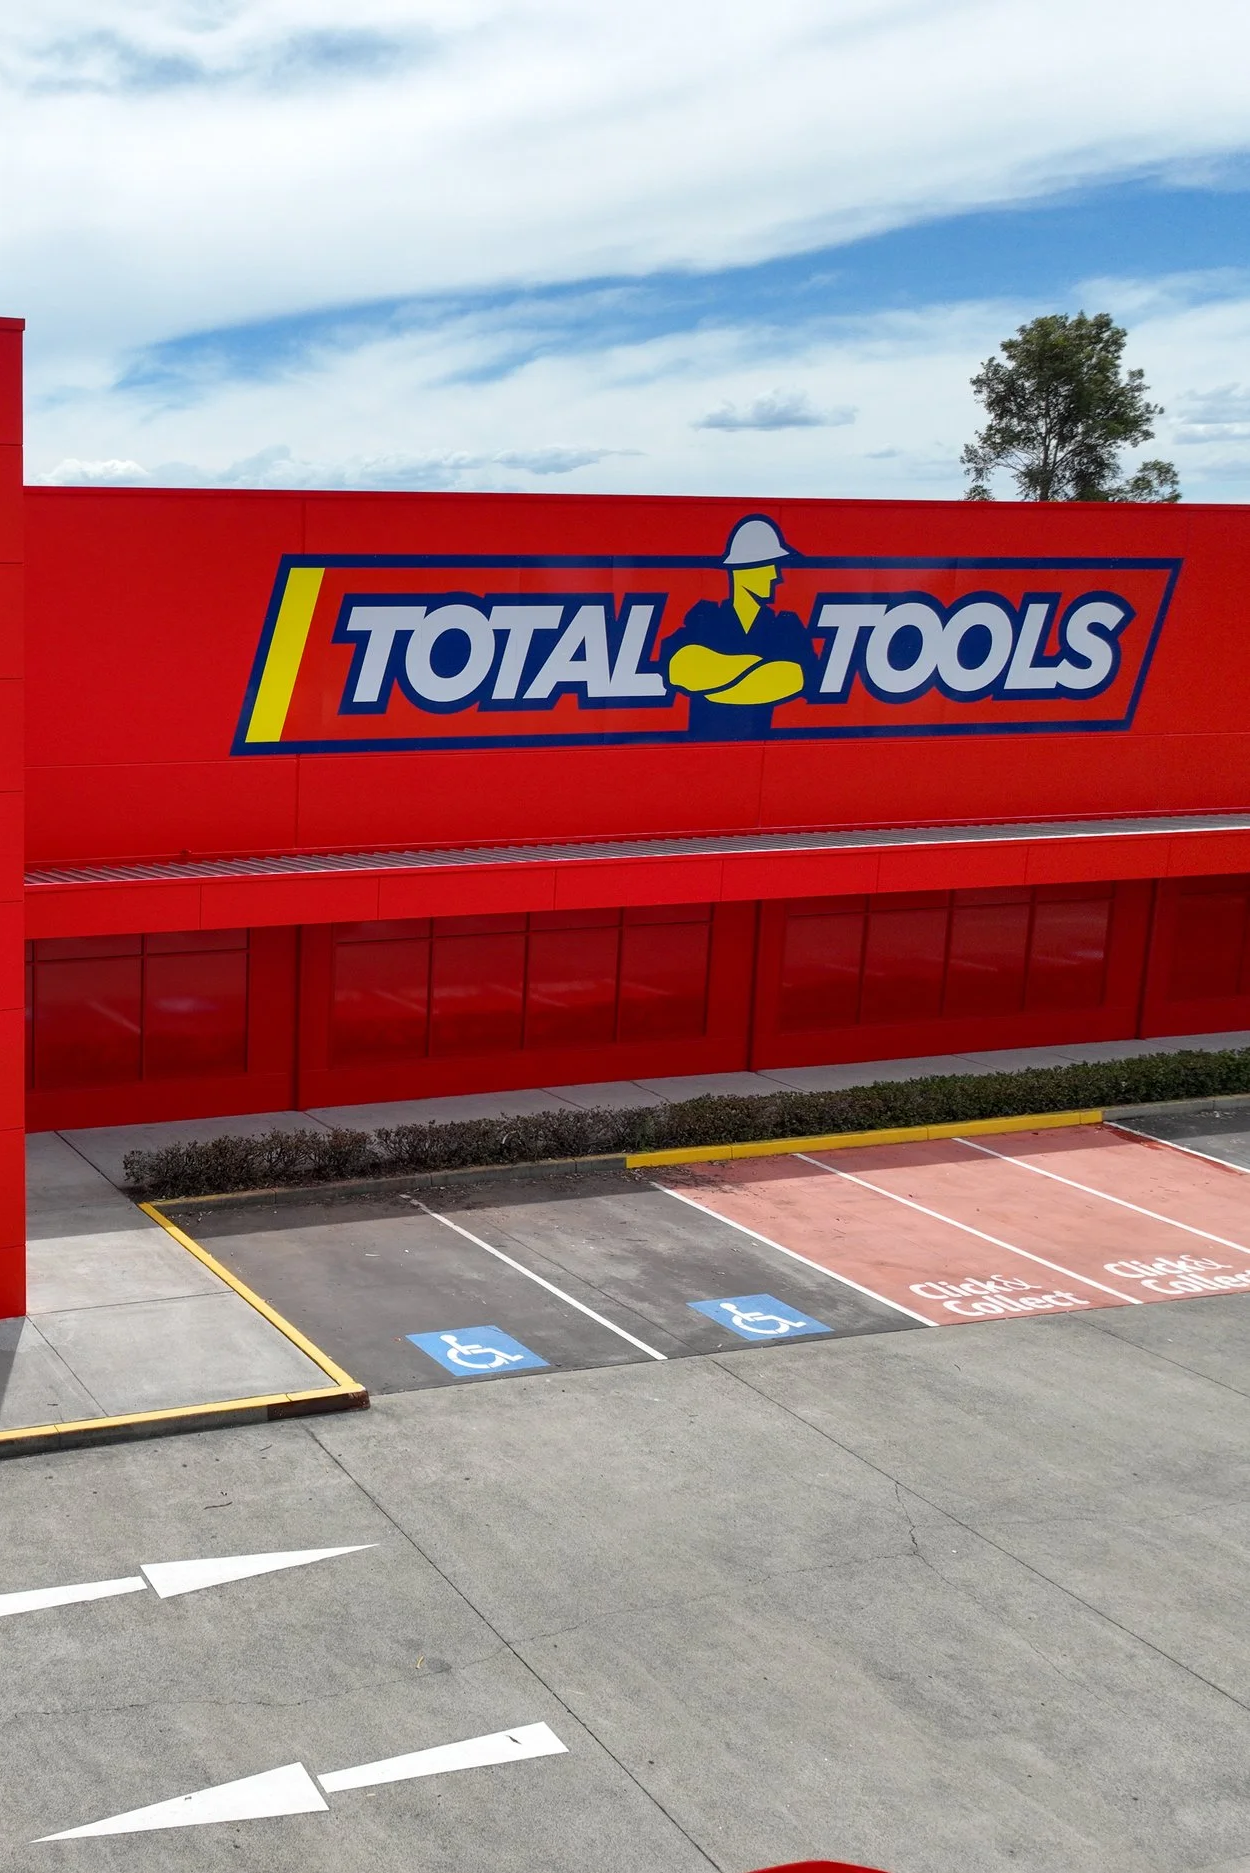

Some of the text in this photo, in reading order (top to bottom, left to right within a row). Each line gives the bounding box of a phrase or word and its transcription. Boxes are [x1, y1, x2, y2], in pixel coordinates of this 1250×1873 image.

[345, 601, 1125, 702] TOTAL TOOLS
[943, 1290, 1090, 1317] Collect
